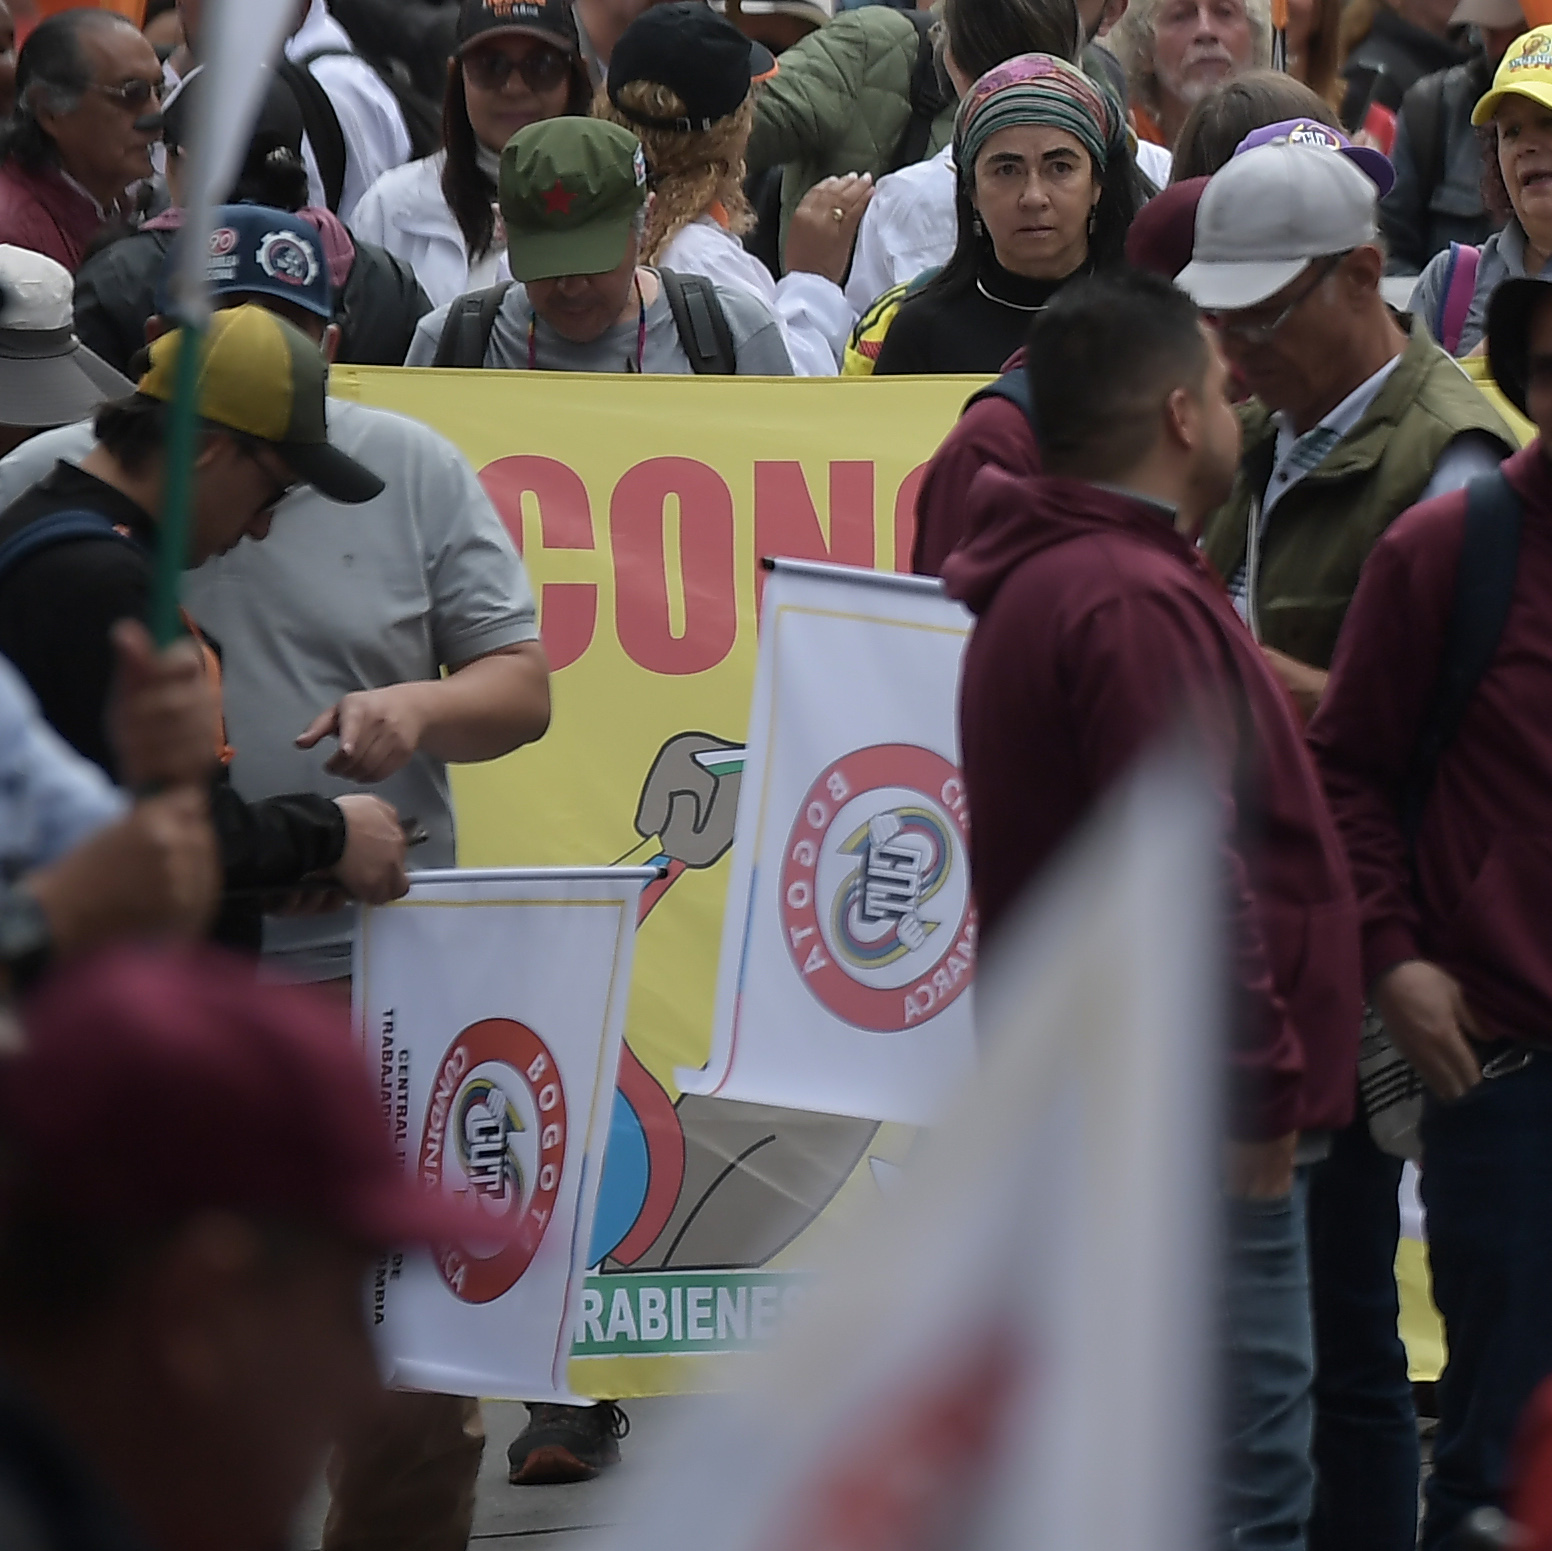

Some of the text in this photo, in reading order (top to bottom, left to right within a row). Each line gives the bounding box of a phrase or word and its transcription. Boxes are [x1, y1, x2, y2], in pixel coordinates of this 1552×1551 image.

[476, 454, 930, 674] CON
[395, 1049, 410, 1145] CENTRAL
[524, 1052, 559, 1248] BOGOT
